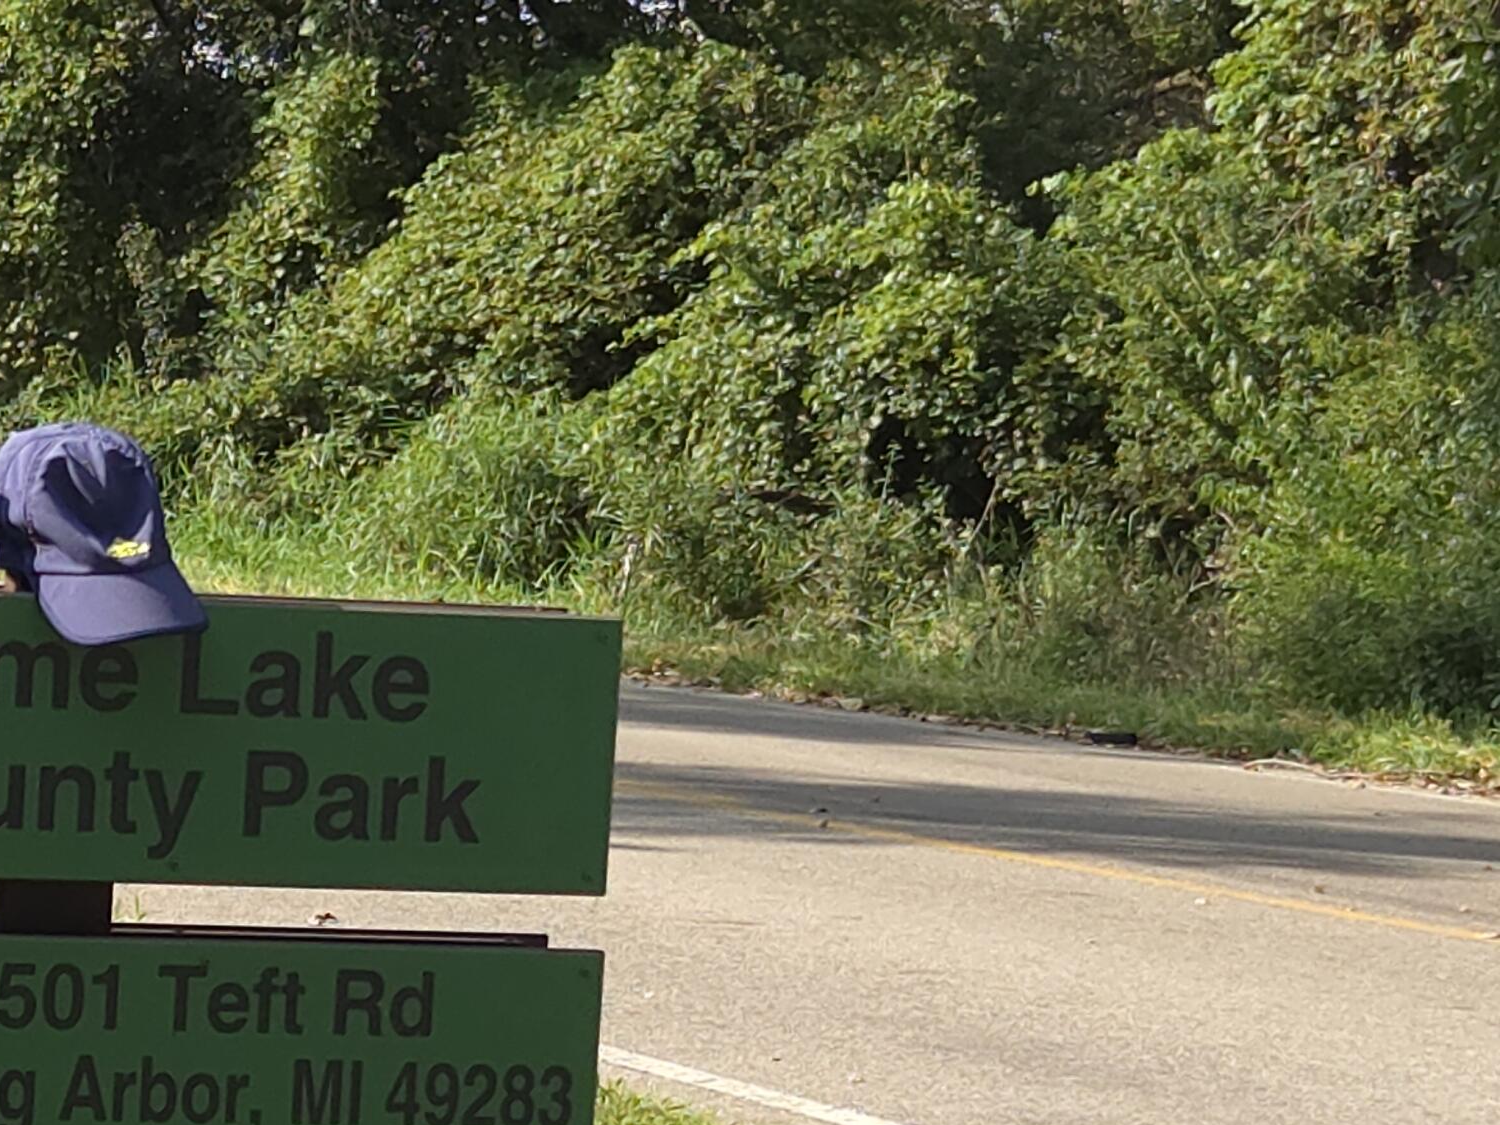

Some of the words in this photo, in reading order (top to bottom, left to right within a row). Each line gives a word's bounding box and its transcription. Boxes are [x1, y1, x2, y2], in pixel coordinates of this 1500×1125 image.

[180, 630, 430, 723] Lake
[242, 750, 481, 844] Park
[158, 964, 304, 1036] Teft
[333, 969, 436, 1038] Rd
